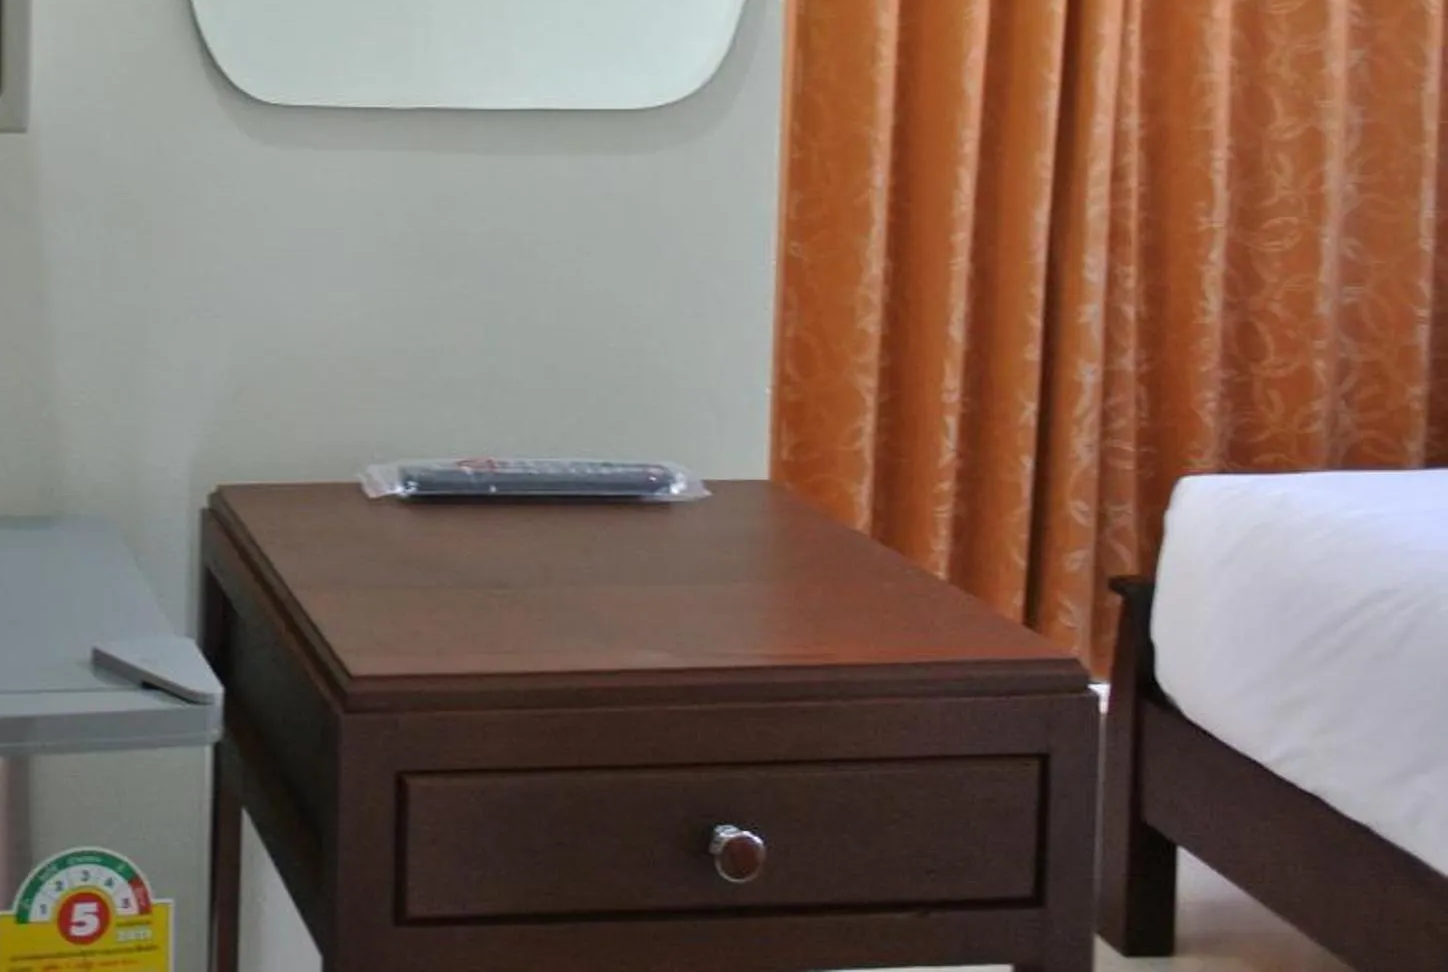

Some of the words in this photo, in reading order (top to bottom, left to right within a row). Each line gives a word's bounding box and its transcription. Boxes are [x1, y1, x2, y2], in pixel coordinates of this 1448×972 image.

[55, 880, 65, 892] 2
[81, 869, 91, 882] 3
[68, 901, 101, 937] 5
